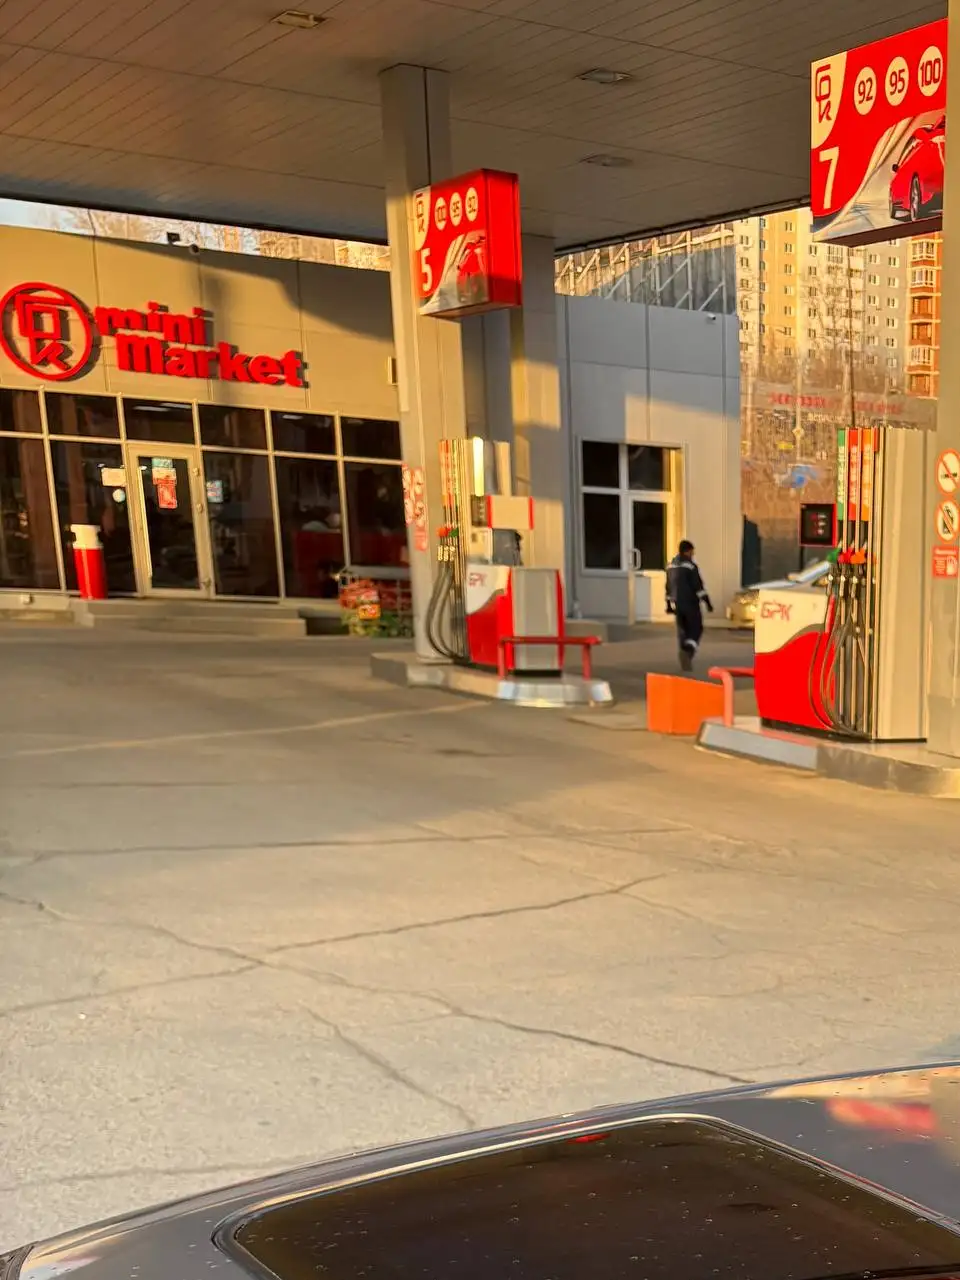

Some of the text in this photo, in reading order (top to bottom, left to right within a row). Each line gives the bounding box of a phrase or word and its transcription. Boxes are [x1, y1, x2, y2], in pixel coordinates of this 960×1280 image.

[858, 58, 940, 104] 92 95 100
[819, 146, 839, 209] 7
[421, 248, 432, 291] 5
[95, 301, 207, 346] mini
